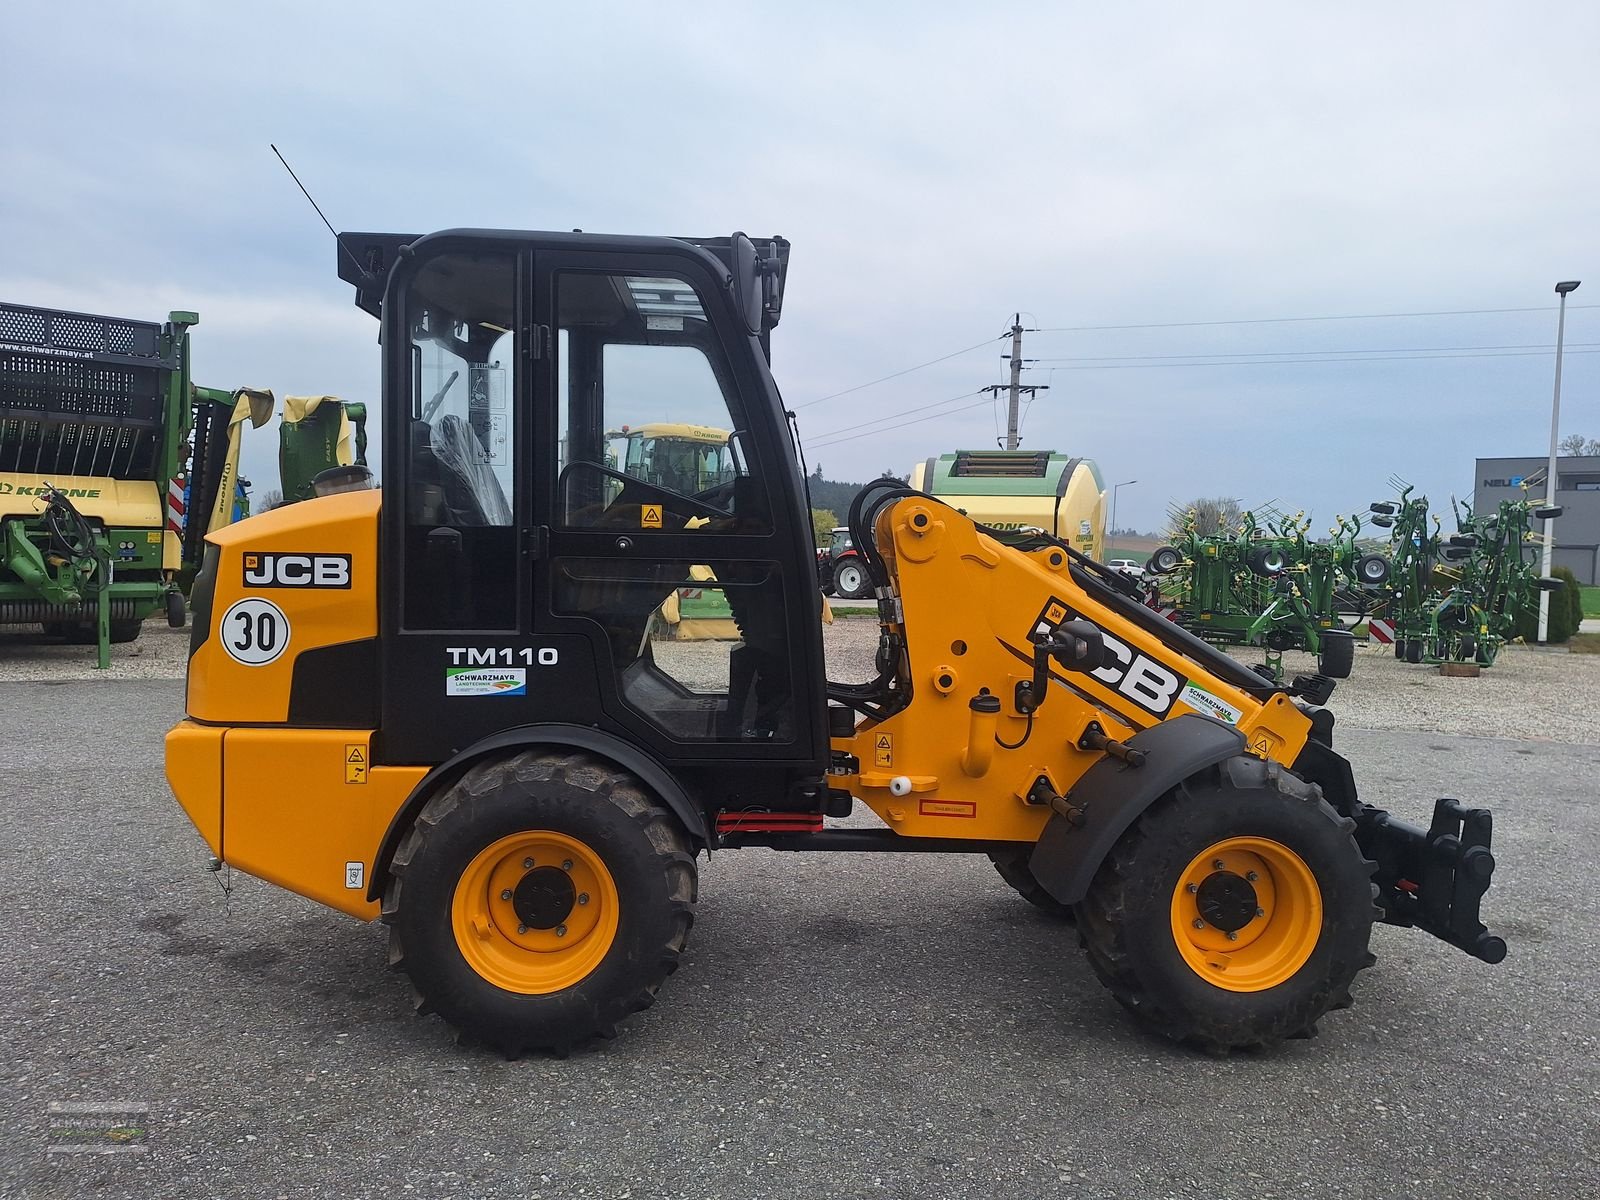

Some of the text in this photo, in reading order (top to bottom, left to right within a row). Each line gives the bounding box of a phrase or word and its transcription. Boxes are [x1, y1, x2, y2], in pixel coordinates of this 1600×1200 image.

[245, 556, 349, 585] JCB
[234, 611, 276, 651] 30
[446, 647, 559, 666] TM110
[1036, 616, 1179, 713] CB
[1188, 688, 1232, 717] SCHWARZMAYR
